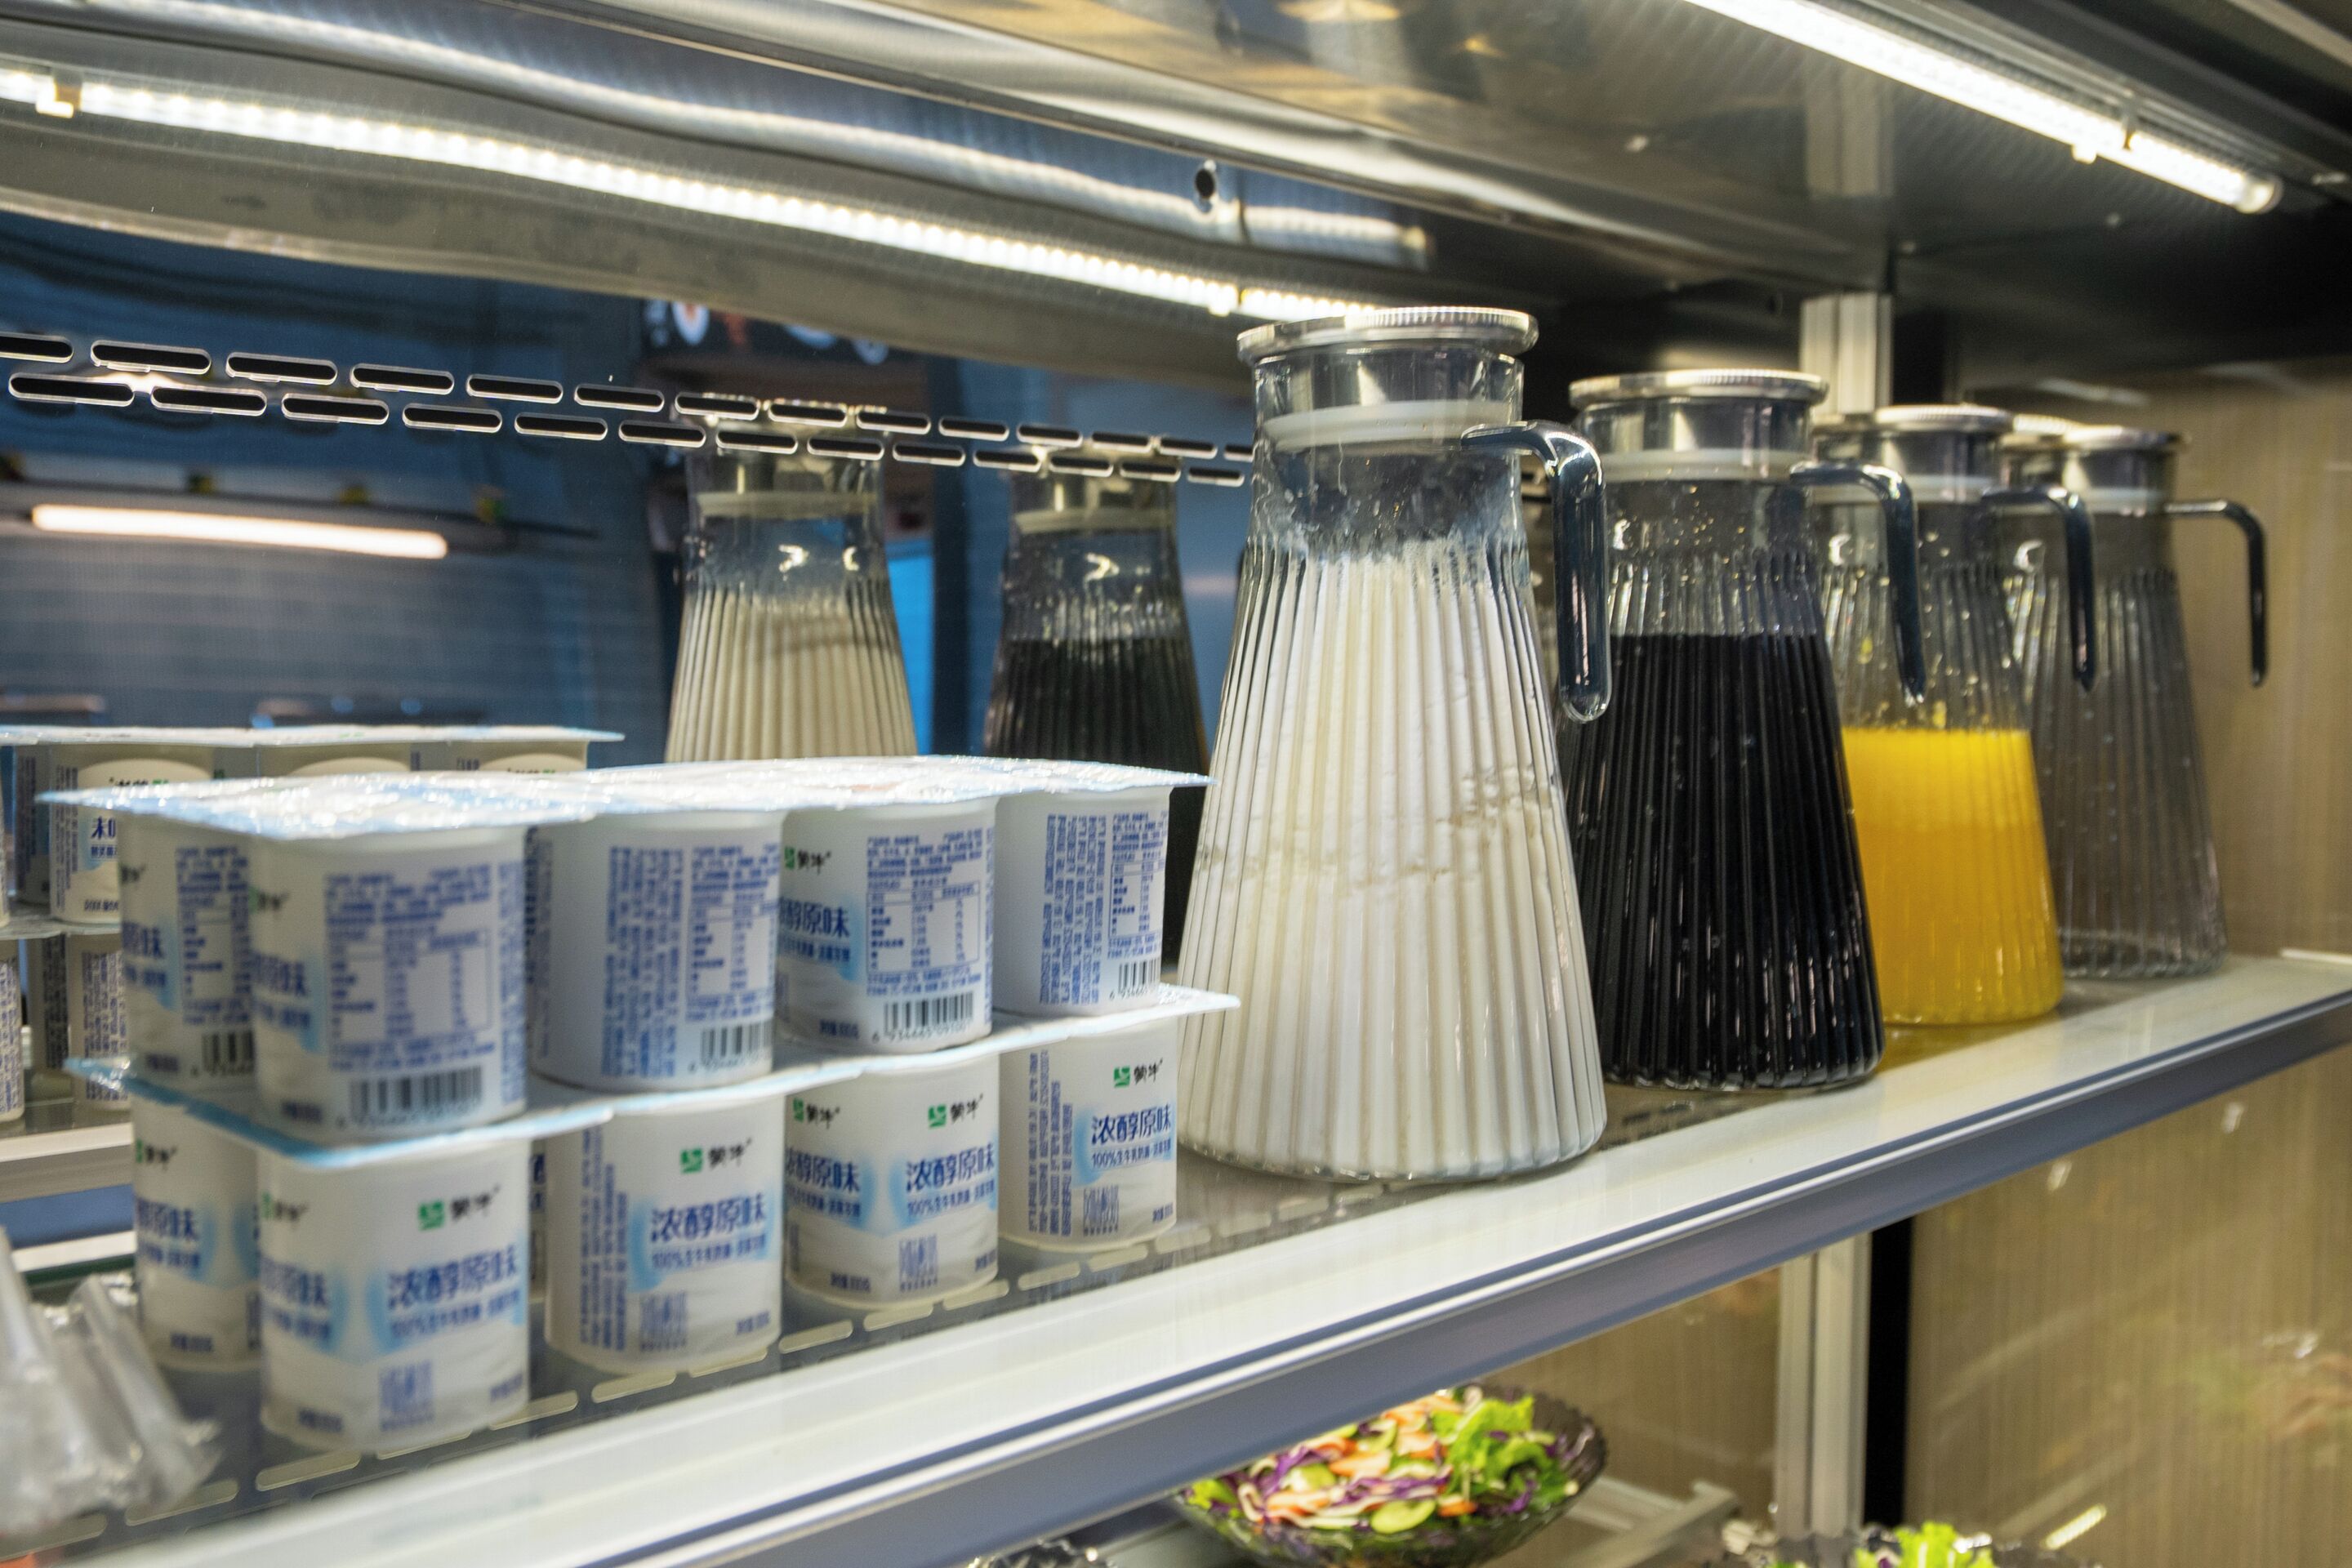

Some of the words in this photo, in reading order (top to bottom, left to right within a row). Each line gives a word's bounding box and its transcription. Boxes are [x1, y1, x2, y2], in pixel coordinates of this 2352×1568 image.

[1091, 1103, 1172, 1146] 浓醇原味
[906, 1142, 996, 1193] 浓醇原味
